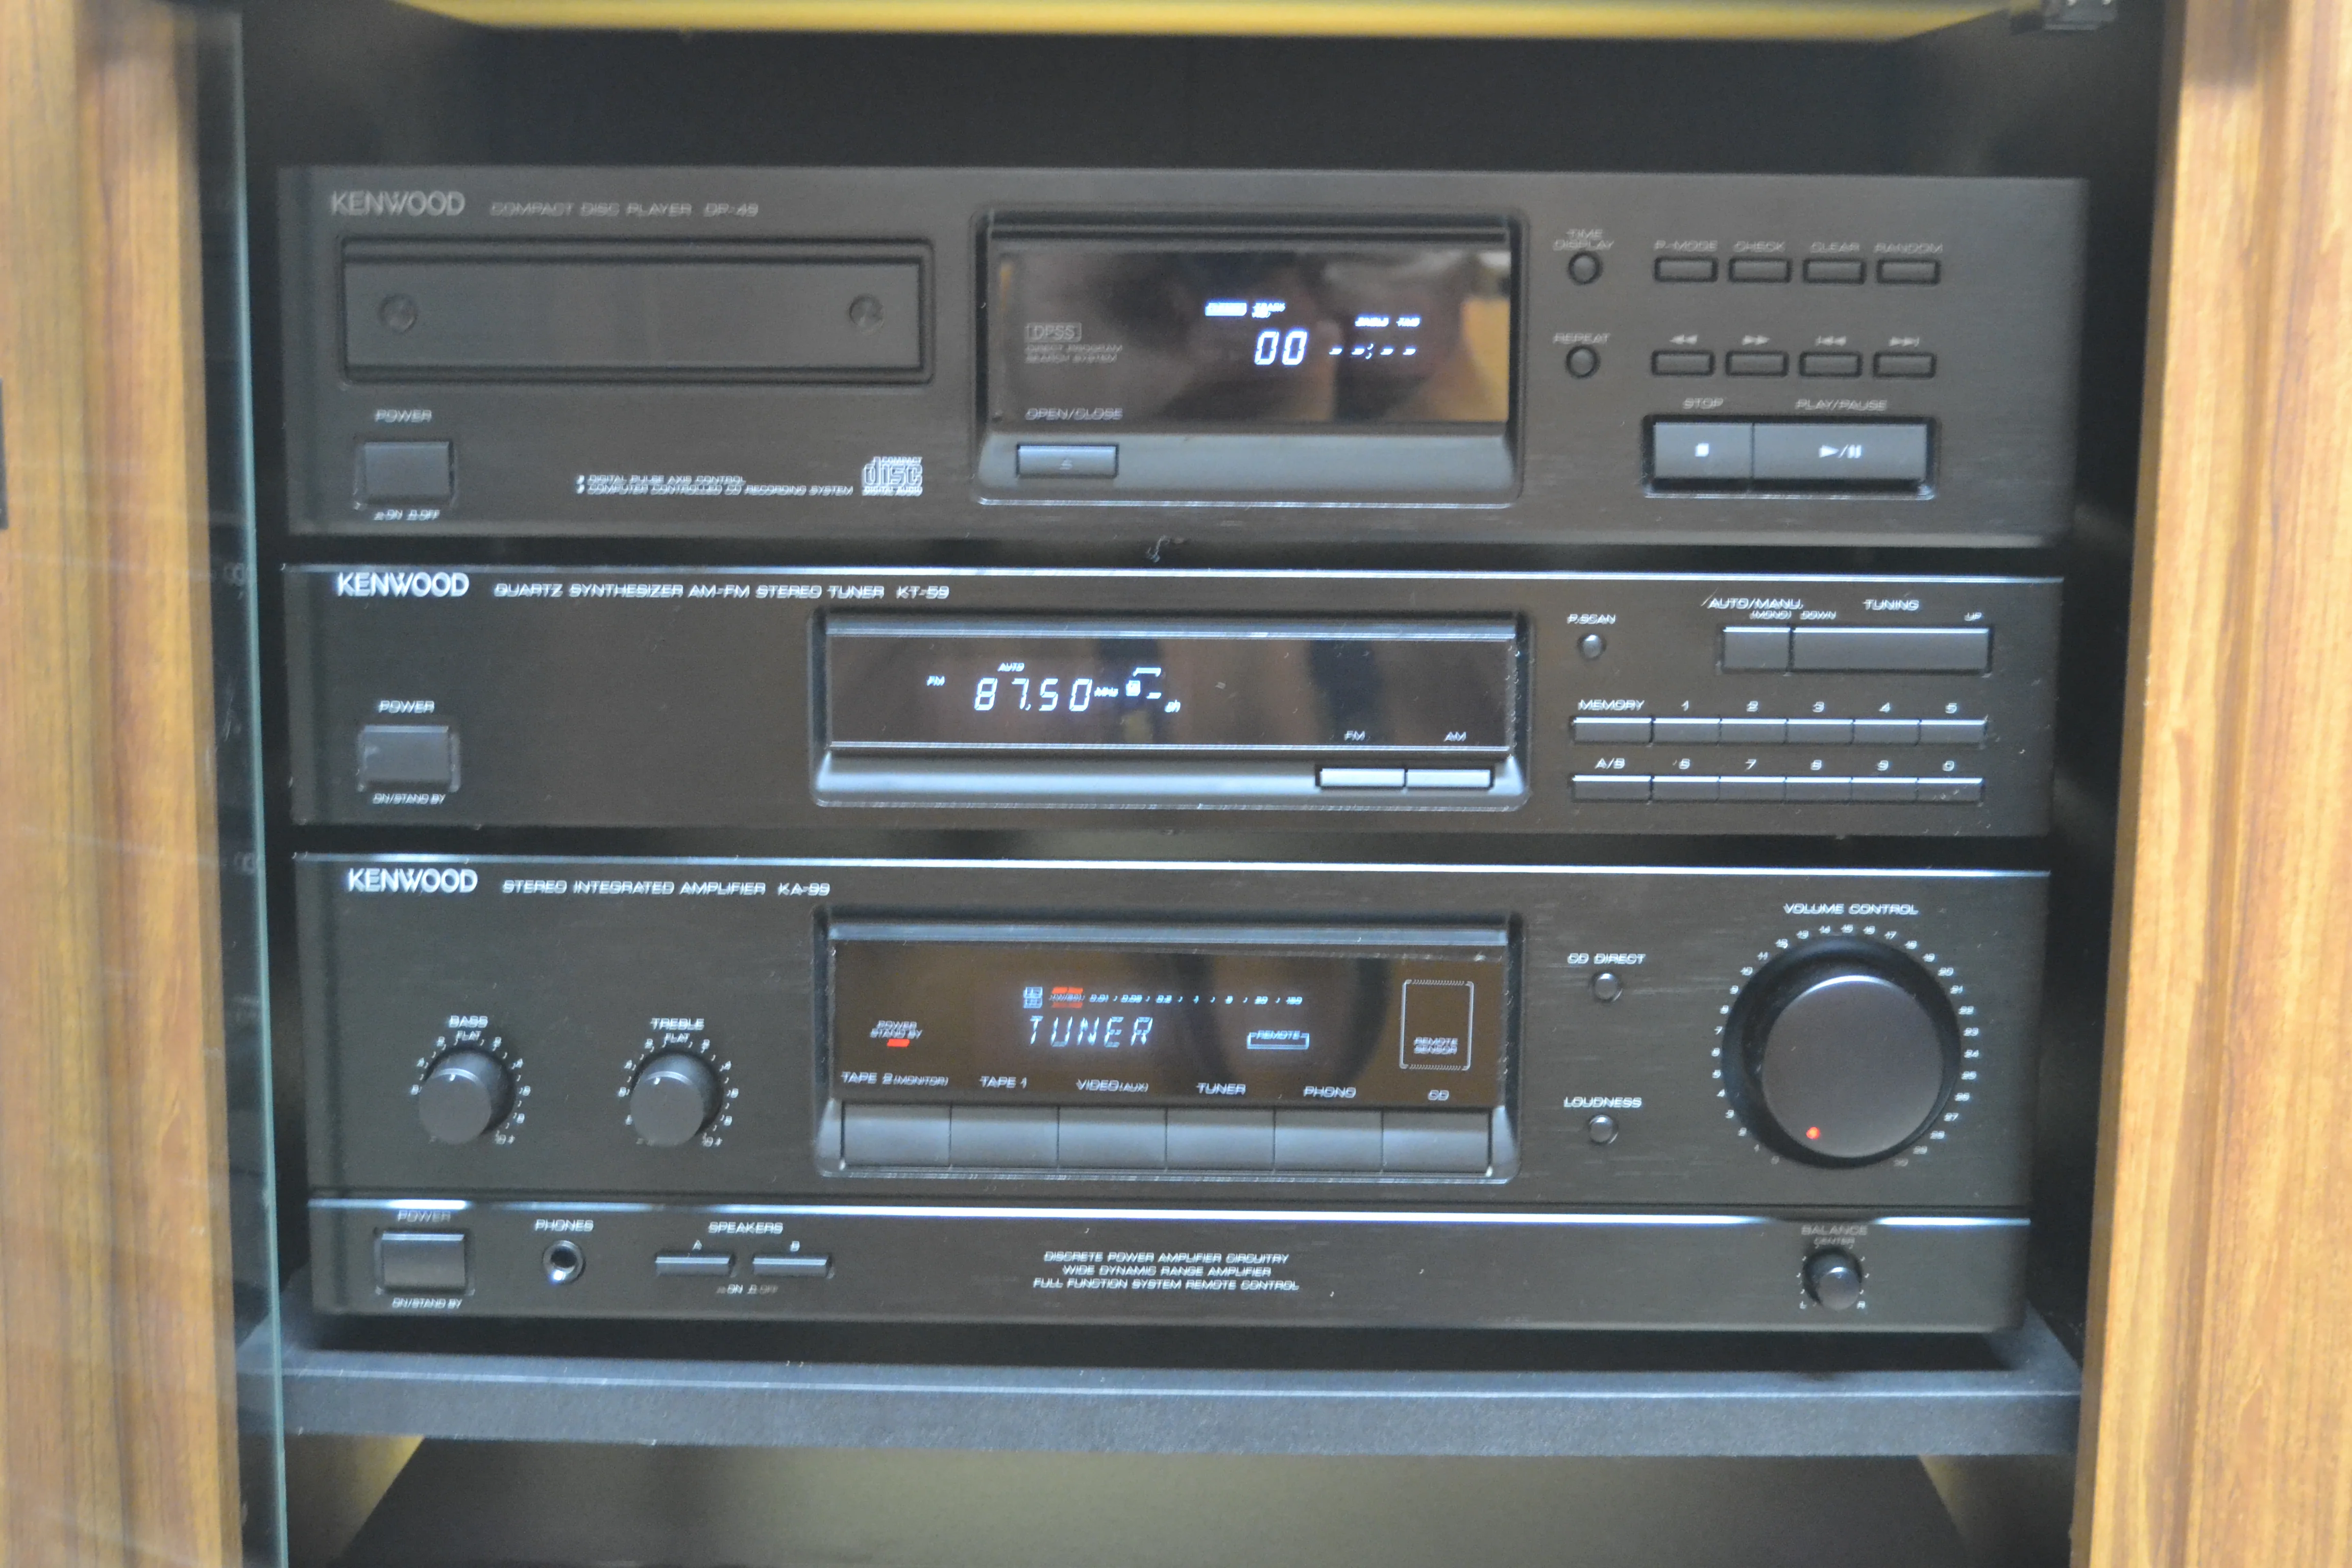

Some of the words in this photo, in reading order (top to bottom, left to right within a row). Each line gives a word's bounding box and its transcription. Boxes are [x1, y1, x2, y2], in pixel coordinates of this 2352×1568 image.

[331, 190, 465, 217] KENWOOD
[489, 202, 575, 217] COMPACT
[579, 202, 620, 217] DISC
[626, 203, 692, 217] PLAYER
[703, 203, 759, 217] DP-49
[1566, 229, 1604, 240] TIME
[1553, 239, 1614, 252] DISPLAY
[1653, 240, 1718, 252] P-MODE
[1732, 241, 1786, 253] CHECK
[1809, 241, 1860, 254] CLEAR
[1873, 241, 1943, 254] RANDOM
[1032, 324, 1077, 341] DPSS
[1553, 332, 1611, 345] REPEAT
[1067, 344, 1123, 353] PROGRAM
[1254, 330, 1308, 366] 00
[1682, 397, 1724, 409] STOP
[1794, 399, 1888, 411] PLAY/PAUSE
[374, 409, 432, 423] POWER
[1024, 408, 1123, 421] OPEN/CLOSE
[587, 474, 627, 485] DIGITAL
[629, 474, 665, 485] PULSE
[667, 475, 692, 485] AXIS
[694, 475, 746, 485] CONTROL
[587, 484, 649, 495] COMPUTER
[650, 484, 723, 495] CONTROLLED
[724, 485, 742, 496] CD
[744, 485, 807, 496] RECORDING
[808, 485, 854, 496] SYSTEM
[862, 485, 895, 496] DIGITAL
[895, 486, 923, 497] AUDIO
[384, 509, 403, 521] ON
[336, 571, 470, 598] KENWOOD
[494, 583, 563, 598] QUARTZ
[568, 583, 683, 598] SYNTHESIZER
[687, 584, 751, 599] AM-FM
[755, 584, 823, 599] STEREO
[826, 585, 885, 599] TUNER
[895, 585, 950, 599] KT-59
[1862, 598, 1920, 611] TUNING
[1566, 613, 1616, 625] P.SCAN
[1749, 609, 1792, 621] (MONO)
[1799, 610, 1837, 621] DOWN
[1964, 611, 1982, 622] UP
[997, 662, 1025, 672] AUTO
[926, 674, 946, 687] FM
[973, 677, 1093, 712] 87.50
[377, 699, 435, 714] POWER
[1578, 699, 1646, 712] MEMORY
[1680, 700, 1689, 712] 1
[1746, 700, 1759, 713] 2
[1811, 701, 1825, 713] 3
[1878, 701, 1891, 714] 4
[1945, 702, 1958, 714] 5
[1343, 730, 1366, 742] FM
[1443, 731, 1467, 743] AM
[1594, 757, 1626, 770] A/B
[1678, 757, 1691, 770] 6
[1744, 758, 1757, 771] 7
[1810, 759, 1823, 771] 8
[1876, 760, 1889, 772] 9
[372, 793, 430, 805] ON/STAND
[430, 793, 447, 805] BY
[348, 868, 479, 894] KENWOOD
[502, 879, 568, 894] STEREO
[572, 879, 675, 895] INTEGRATED
[679, 881, 767, 896] AMPLIFIER
[777, 882, 830, 896] KA-99
[1783, 903, 1845, 915] VOLUME
[1848, 903, 1920, 916] CONTROL
[1566, 952, 1589, 964] CD
[1593, 953, 1647, 965] DIRECT
[448, 1014, 488, 1028] BASS
[650, 1017, 705, 1031] TREBLE
[876, 1020, 918, 1030] POWER
[455, 1030, 482, 1041] FLAT
[664, 1033, 691, 1043] FLAT
[869, 1028, 906, 1039] STAND
[908, 1028, 923, 1039] BY
[1029, 1015, 1154, 1048] TUNER
[1255, 1030, 1301, 1040] REMOTE
[1413, 1037, 1458, 1046] REMOTE
[1413, 1045, 1458, 1055] SENSOR
[840, 1071, 878, 1085] TAPE
[978, 1075, 1017, 1089] TAPE
[1020, 1076, 1027, 1089] 1
[1196, 1082, 1246, 1096] TUNER
[1302, 1085, 1357, 1098] PHONO
[1427, 1088, 1450, 1101] CD
[1563, 1096, 1643, 1108] LOUDNESS
[397, 1210, 451, 1222] POWER
[534, 1218, 595, 1233] PHONES
[707, 1221, 784, 1235] SPEAKERS
[1800, 1224, 1869, 1236] BALANCE
[692, 1239, 703, 1251] A
[790, 1240, 800, 1252] B
[1043, 1251, 1104, 1262] DISCRETE
[1107, 1251, 1155, 1263] POWER
[1157, 1252, 1222, 1263] AMPLIFIER
[1225, 1253, 1290, 1264] CIRCUITRY
[1062, 1264, 1095, 1276] WIDE
[1098, 1265, 1157, 1277] DYNAMIC
[1160, 1266, 1204, 1277] RANGE
[1207, 1266, 1272, 1278] AMPLIFIER
[726, 1284, 744, 1295] ON
[1033, 1277, 1064, 1289] FULL
[1066, 1278, 1129, 1289] FUNCTION
[1131, 1279, 1183, 1290] SYSTEM
[1185, 1279, 1237, 1290] REMOTE
[1240, 1280, 1301, 1291] CONTROL
[392, 1297, 446, 1310] ON/STAND
[447, 1298, 462, 1310] BY
